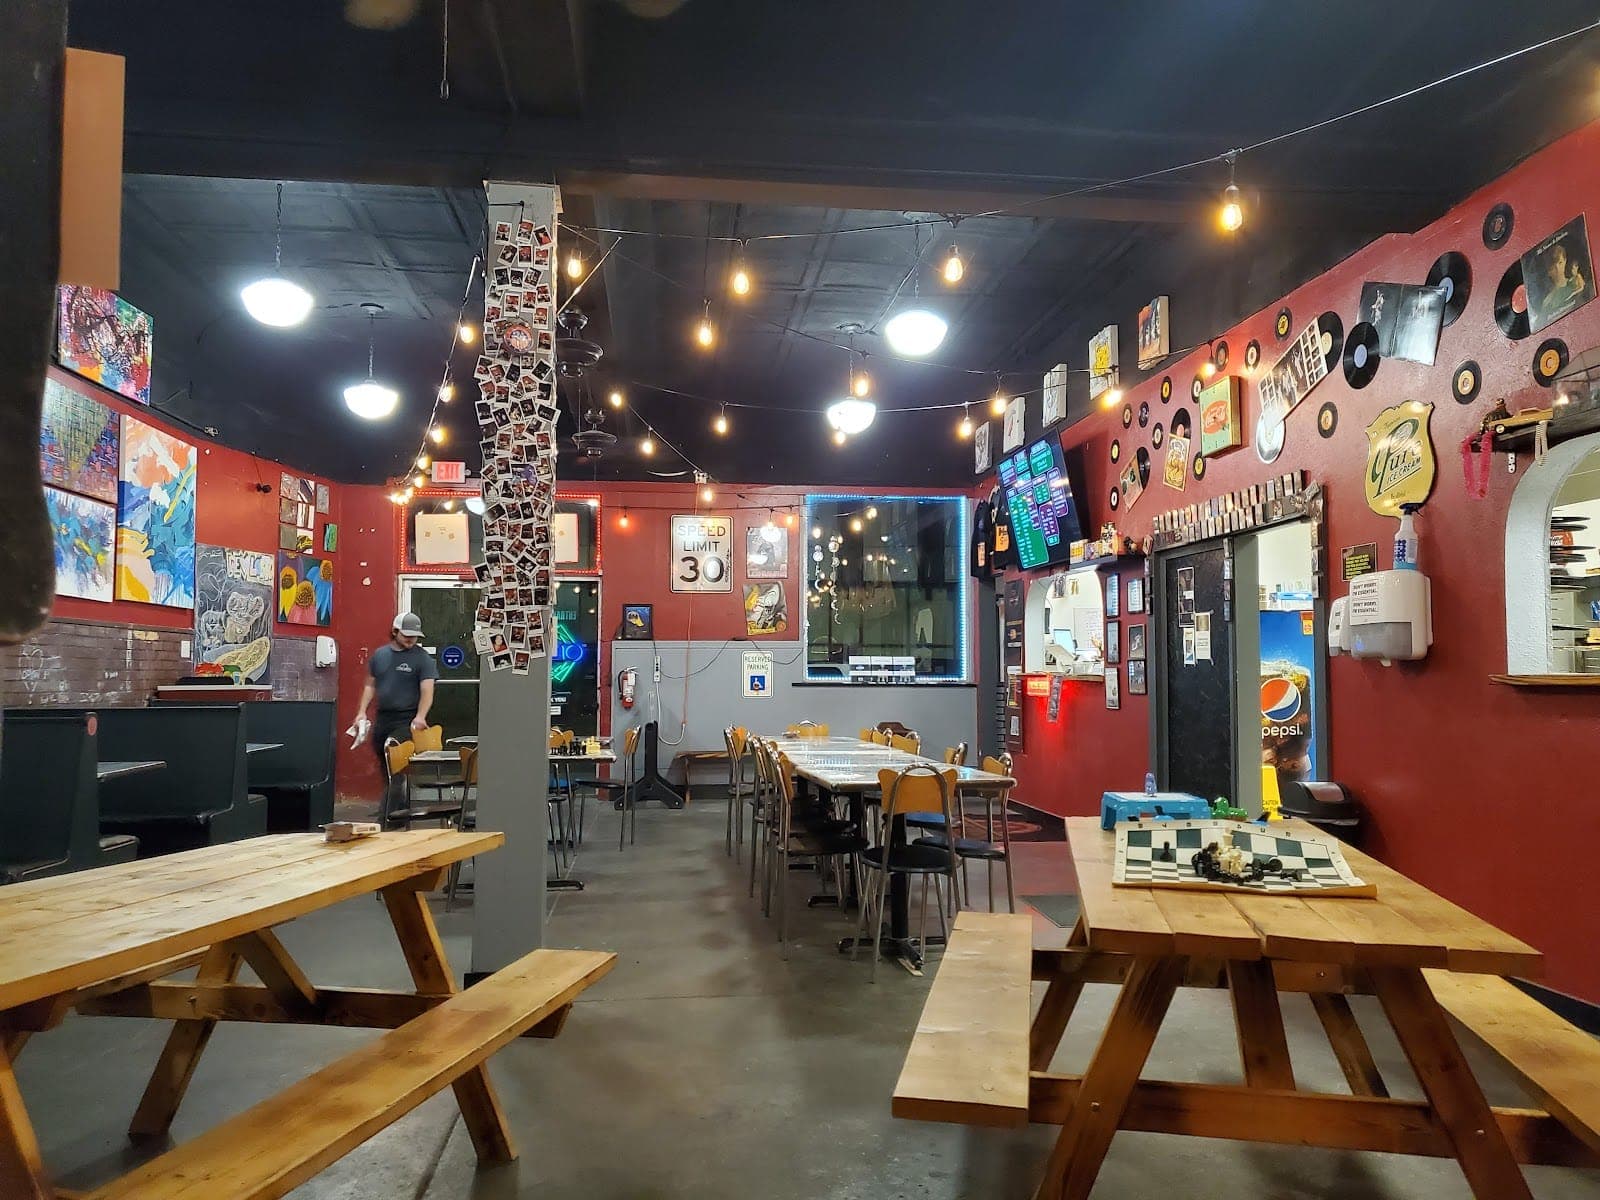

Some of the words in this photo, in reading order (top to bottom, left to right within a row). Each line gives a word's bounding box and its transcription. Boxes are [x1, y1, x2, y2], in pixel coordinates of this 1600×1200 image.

[436, 463, 460, 480] EXIT
[1387, 475, 1397, 485] ICE
[1398, 456, 1422, 477] CREAM
[678, 525, 726, 537] SPEED
[683, 540, 720, 552] LIMIT
[679, 556, 725, 583] 30
[744, 655, 770, 663] RESERVED
[746, 663, 769, 671] PARKING
[1261, 723, 1301, 739] pepsi
